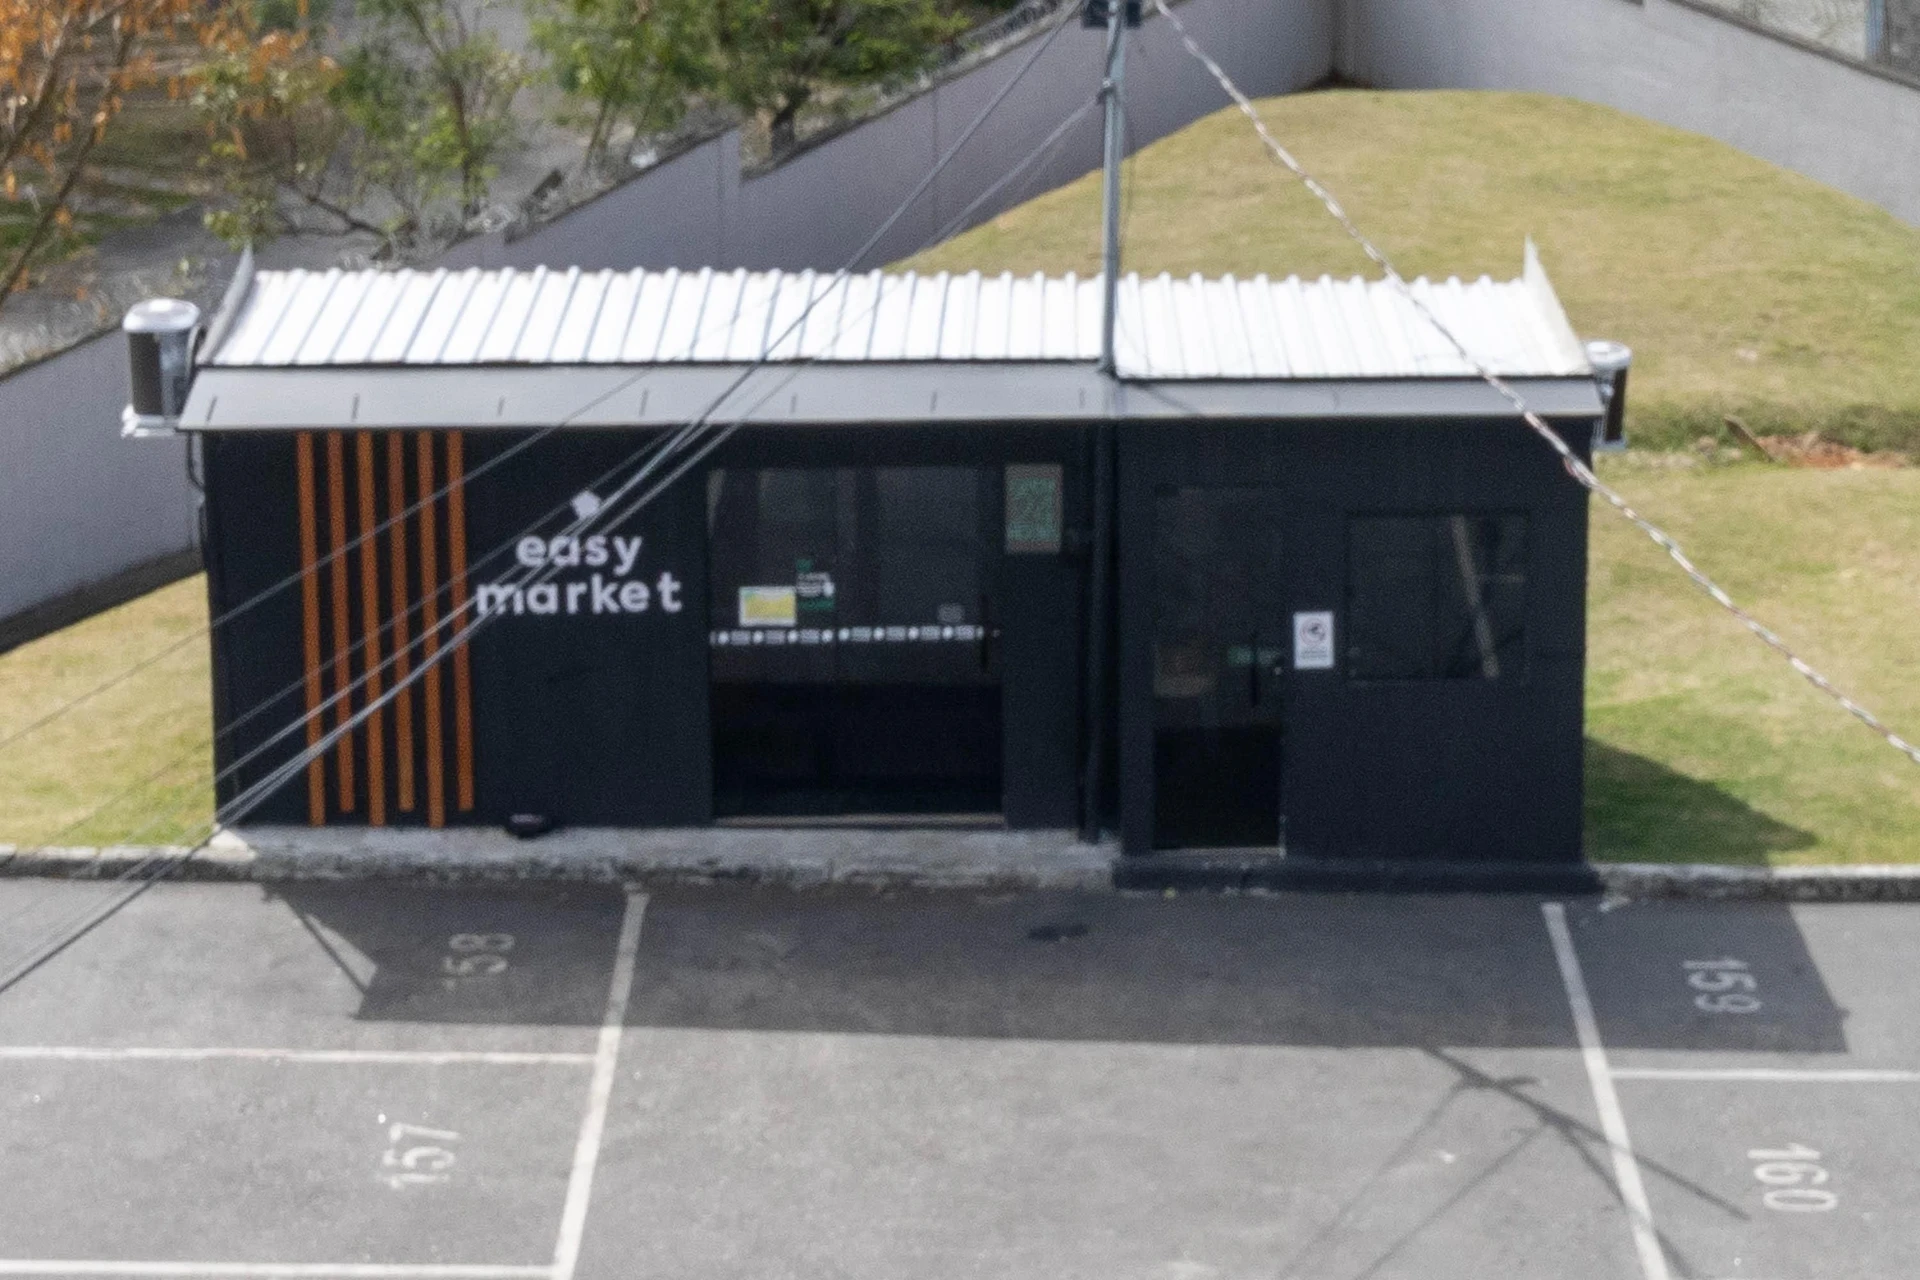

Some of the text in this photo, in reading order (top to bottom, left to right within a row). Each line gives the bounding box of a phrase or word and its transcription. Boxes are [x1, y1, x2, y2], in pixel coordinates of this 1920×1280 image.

[515, 535, 642, 577] easy
[475, 572, 682, 616] market
[1682, 956, 1762, 1013] 159
[376, 1121, 460, 1189] 157
[1747, 1142, 1838, 1212] 160
